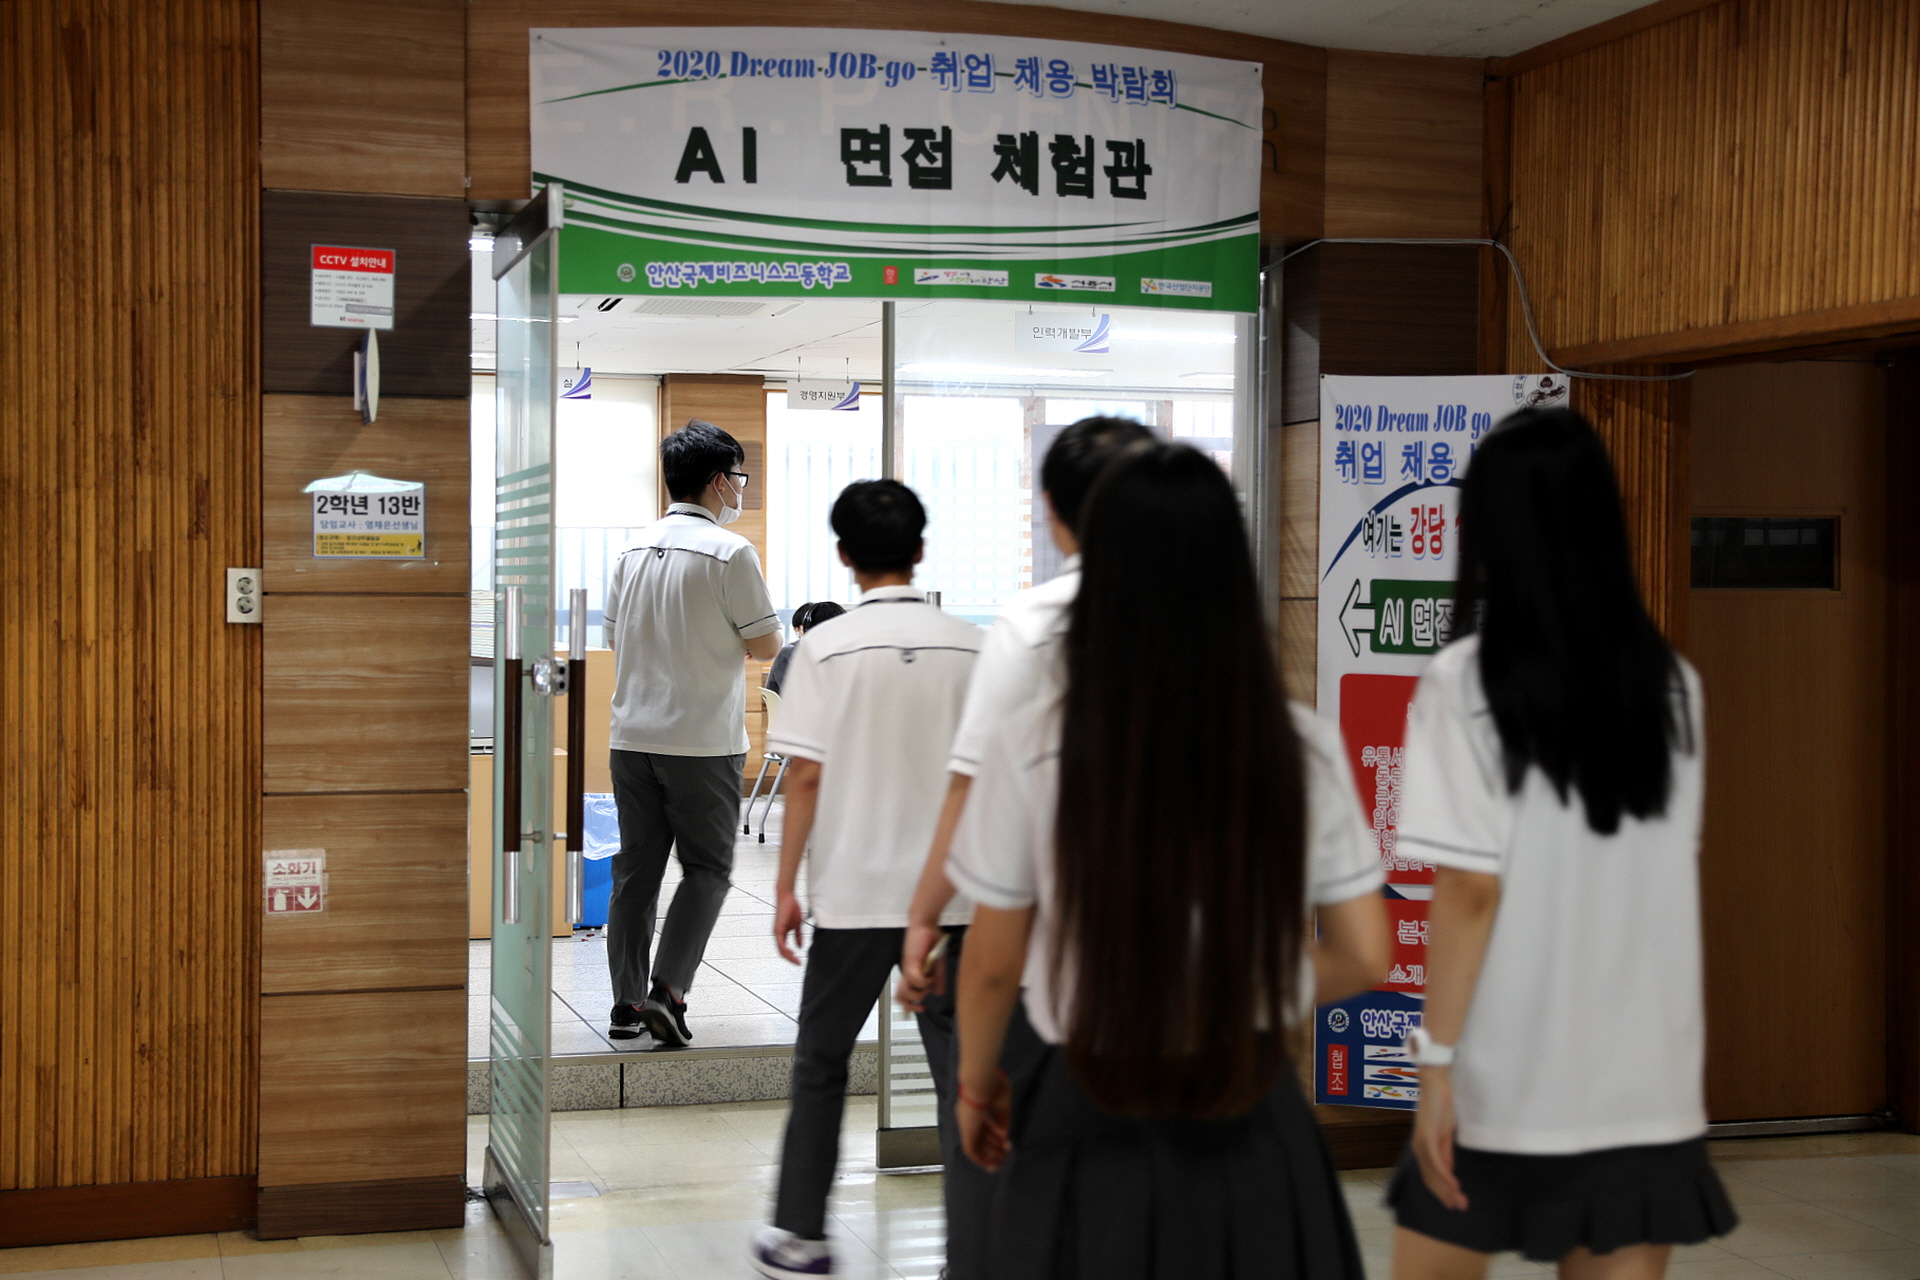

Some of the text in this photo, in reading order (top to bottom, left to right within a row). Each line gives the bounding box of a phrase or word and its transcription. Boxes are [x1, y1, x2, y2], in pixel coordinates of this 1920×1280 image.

[657, 50, 1177, 106] 2020 Dream JOB go 취업 채용 박람회
[674, 124, 1152, 200] AI 면접 체험관
[319, 255, 387, 268] CCTV 설치안내
[646, 262, 851, 289] 안산국제비즈니스고등학교
[1032, 326, 1092, 340] 인력개발부
[800, 390, 845, 401] 경영지원부
[1335, 404, 1491, 439] 2020 Dream JOB go
[1334, 440, 1384, 482] 취업
[1400, 440, 1454, 483] 채용
[317, 494, 421, 516] 2학년 13반
[320, 520, 356, 530] 담임교사
[1362, 510, 1403, 555] 여기는
[1410, 503, 1446, 556] 강당
[1379, 598, 1404, 645] AI
[273, 861, 317, 875] 소화기
[1360, 1008, 1423, 1038] 안산국제
[1330, 1050, 1344, 1091] 협조
